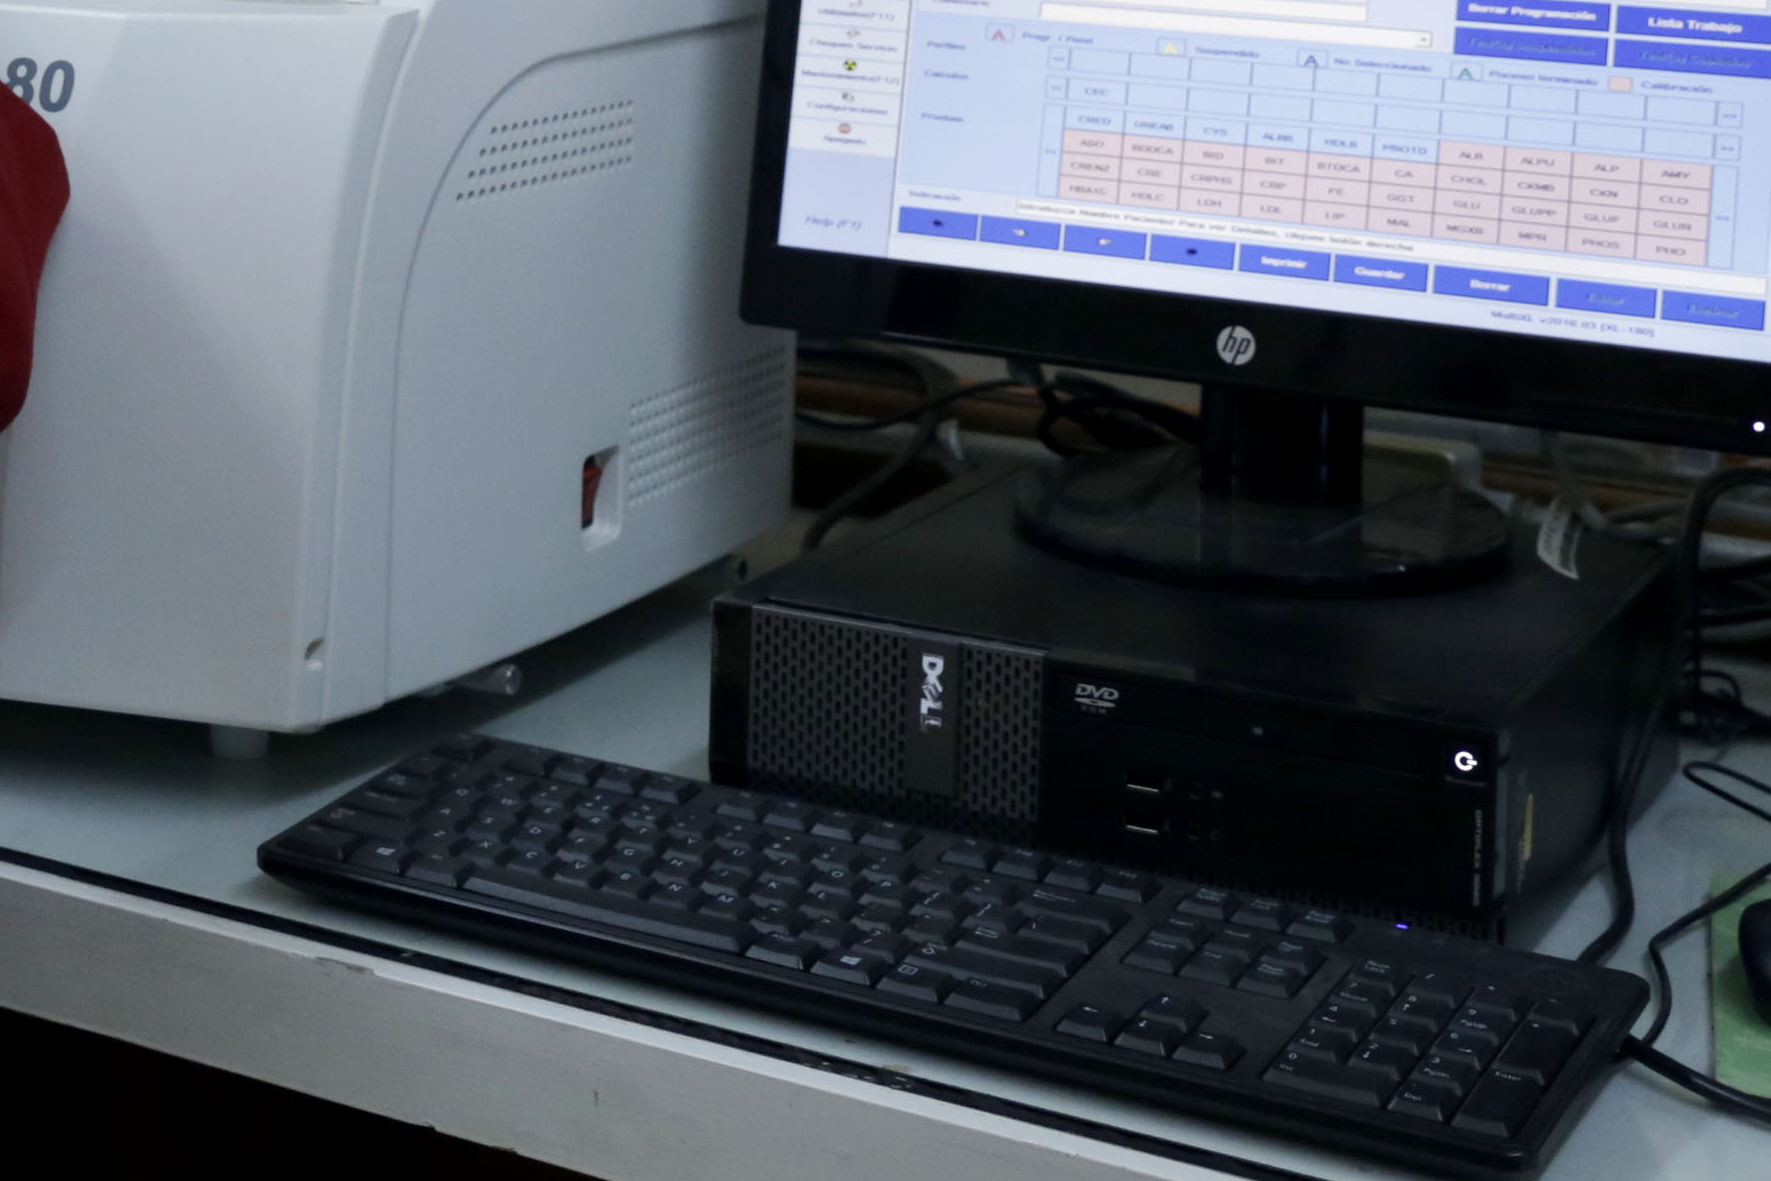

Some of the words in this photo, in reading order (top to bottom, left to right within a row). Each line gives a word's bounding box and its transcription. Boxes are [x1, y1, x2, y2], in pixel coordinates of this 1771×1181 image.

[1467, 3, 1509, 16] Borrar
[1511, 6, 1598, 22] Programación
[1647, 17, 1684, 30] Lista
[1687, 19, 1744, 35] Trabajo
[1640, 80, 1715, 94] Calibración
[1393, 168, 1415, 179] CA
[1327, 186, 1345, 197] FE
[1353, 265, 1406, 280] Guardar
[1469, 278, 1513, 292] Borrar
[1218, 326, 1255, 365] hp
[919, 652, 946, 730] DELL
[1074, 682, 1121, 701] DVD
[1493, 1069, 1523, 1082] Enter
